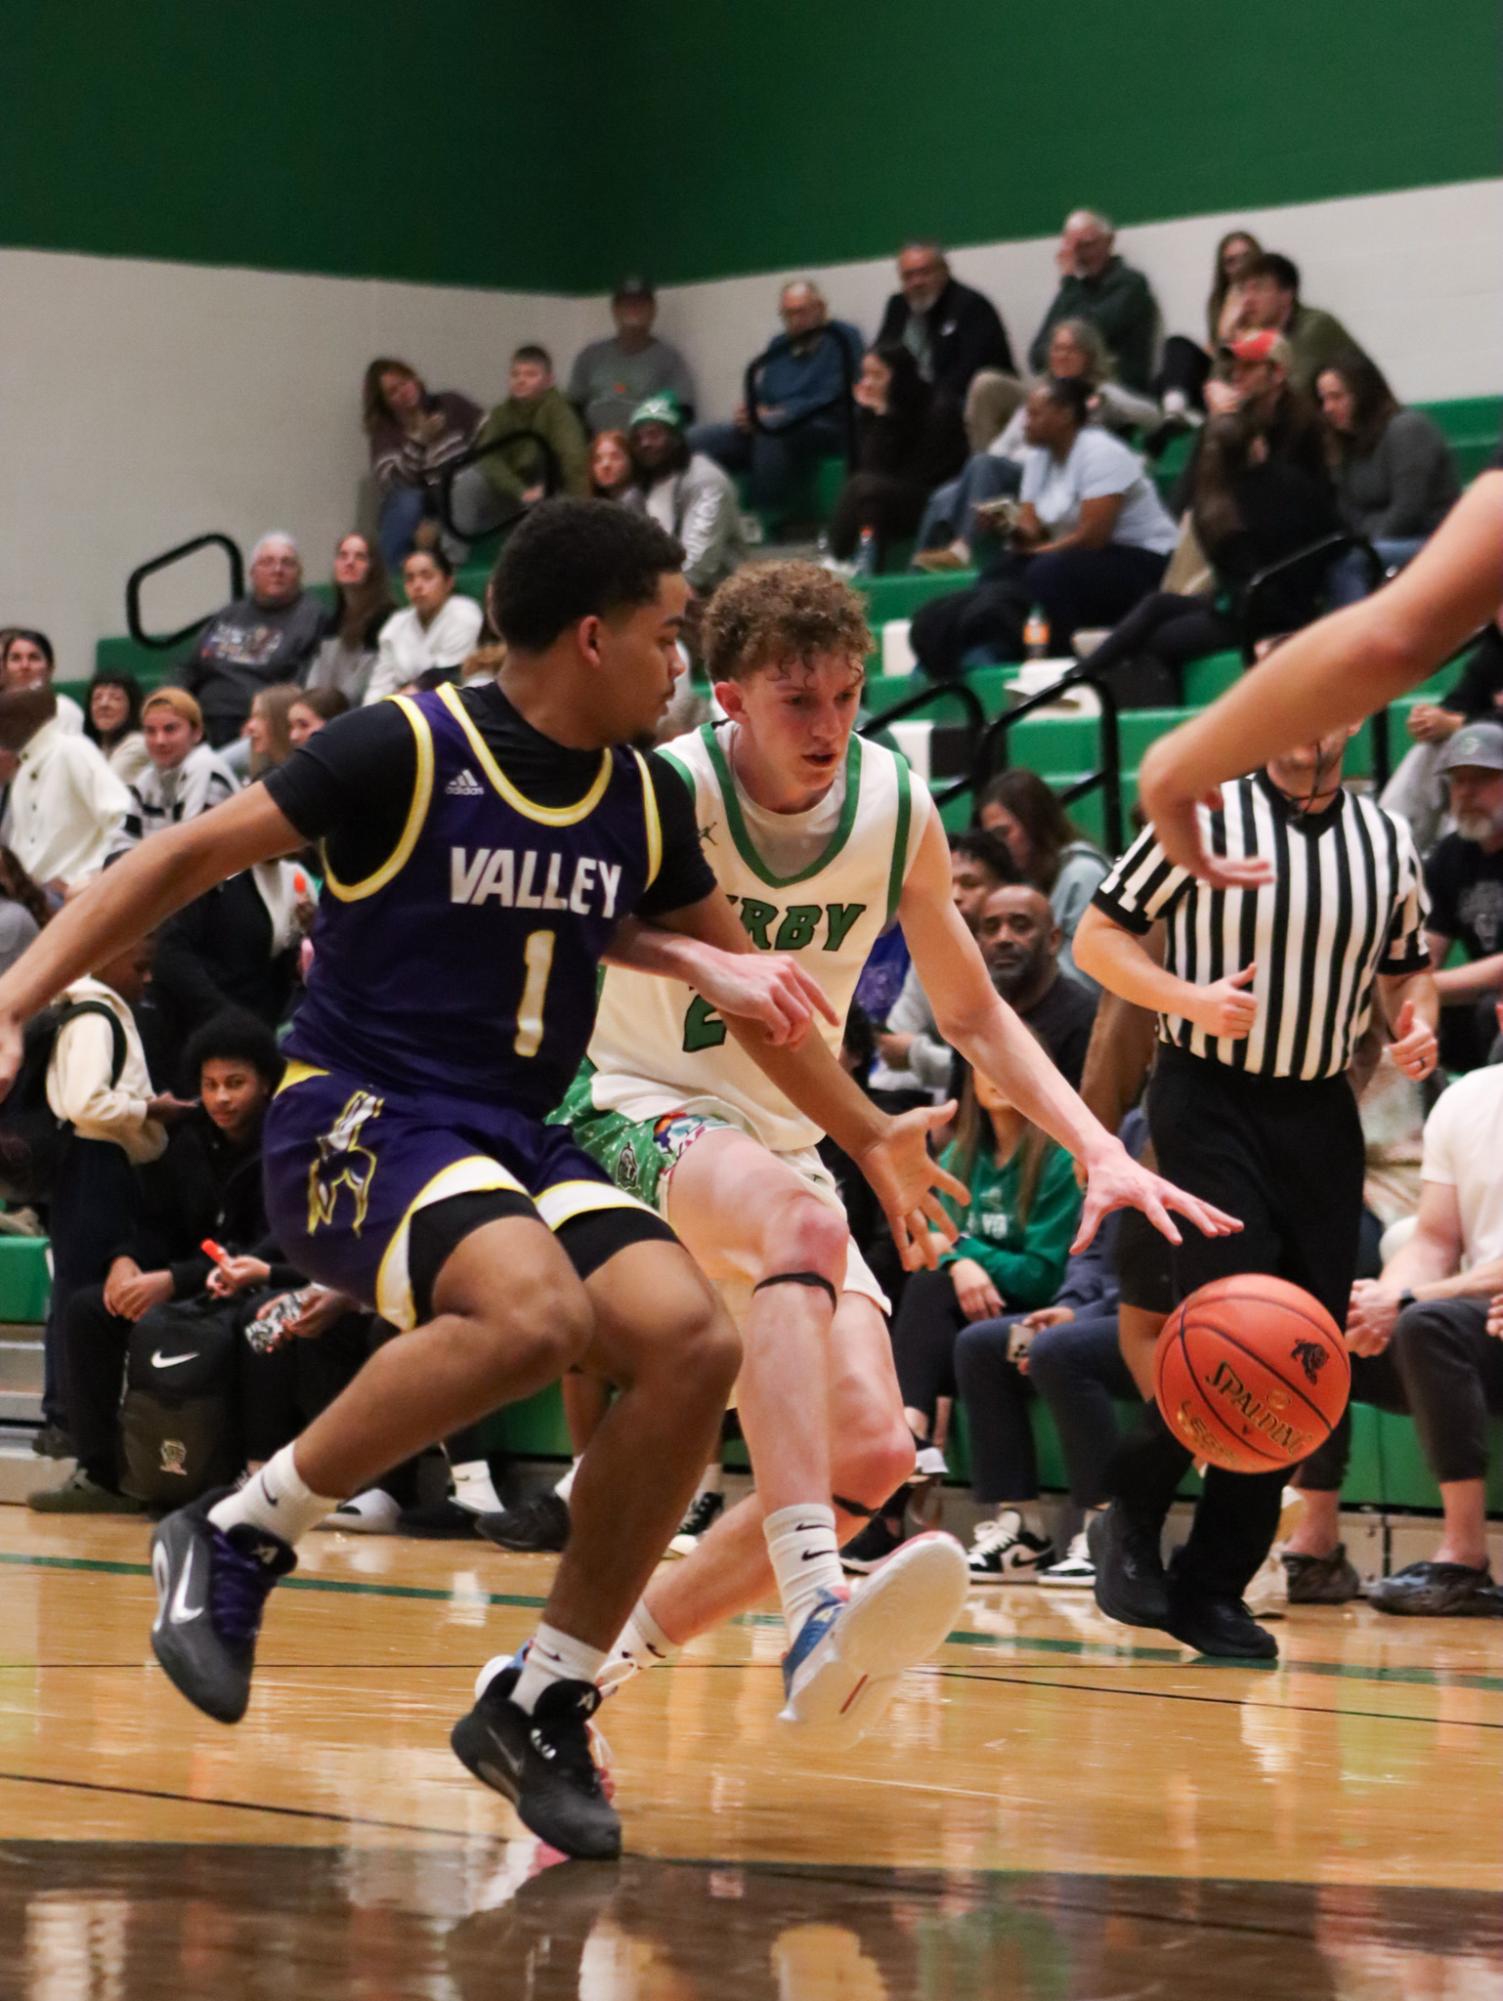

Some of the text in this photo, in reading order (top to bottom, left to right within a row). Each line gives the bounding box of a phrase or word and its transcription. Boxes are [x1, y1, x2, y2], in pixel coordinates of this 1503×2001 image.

[450, 847, 622, 918] VALLEY
[725, 894, 868, 951] RBY
[514, 930, 556, 1058] 1
